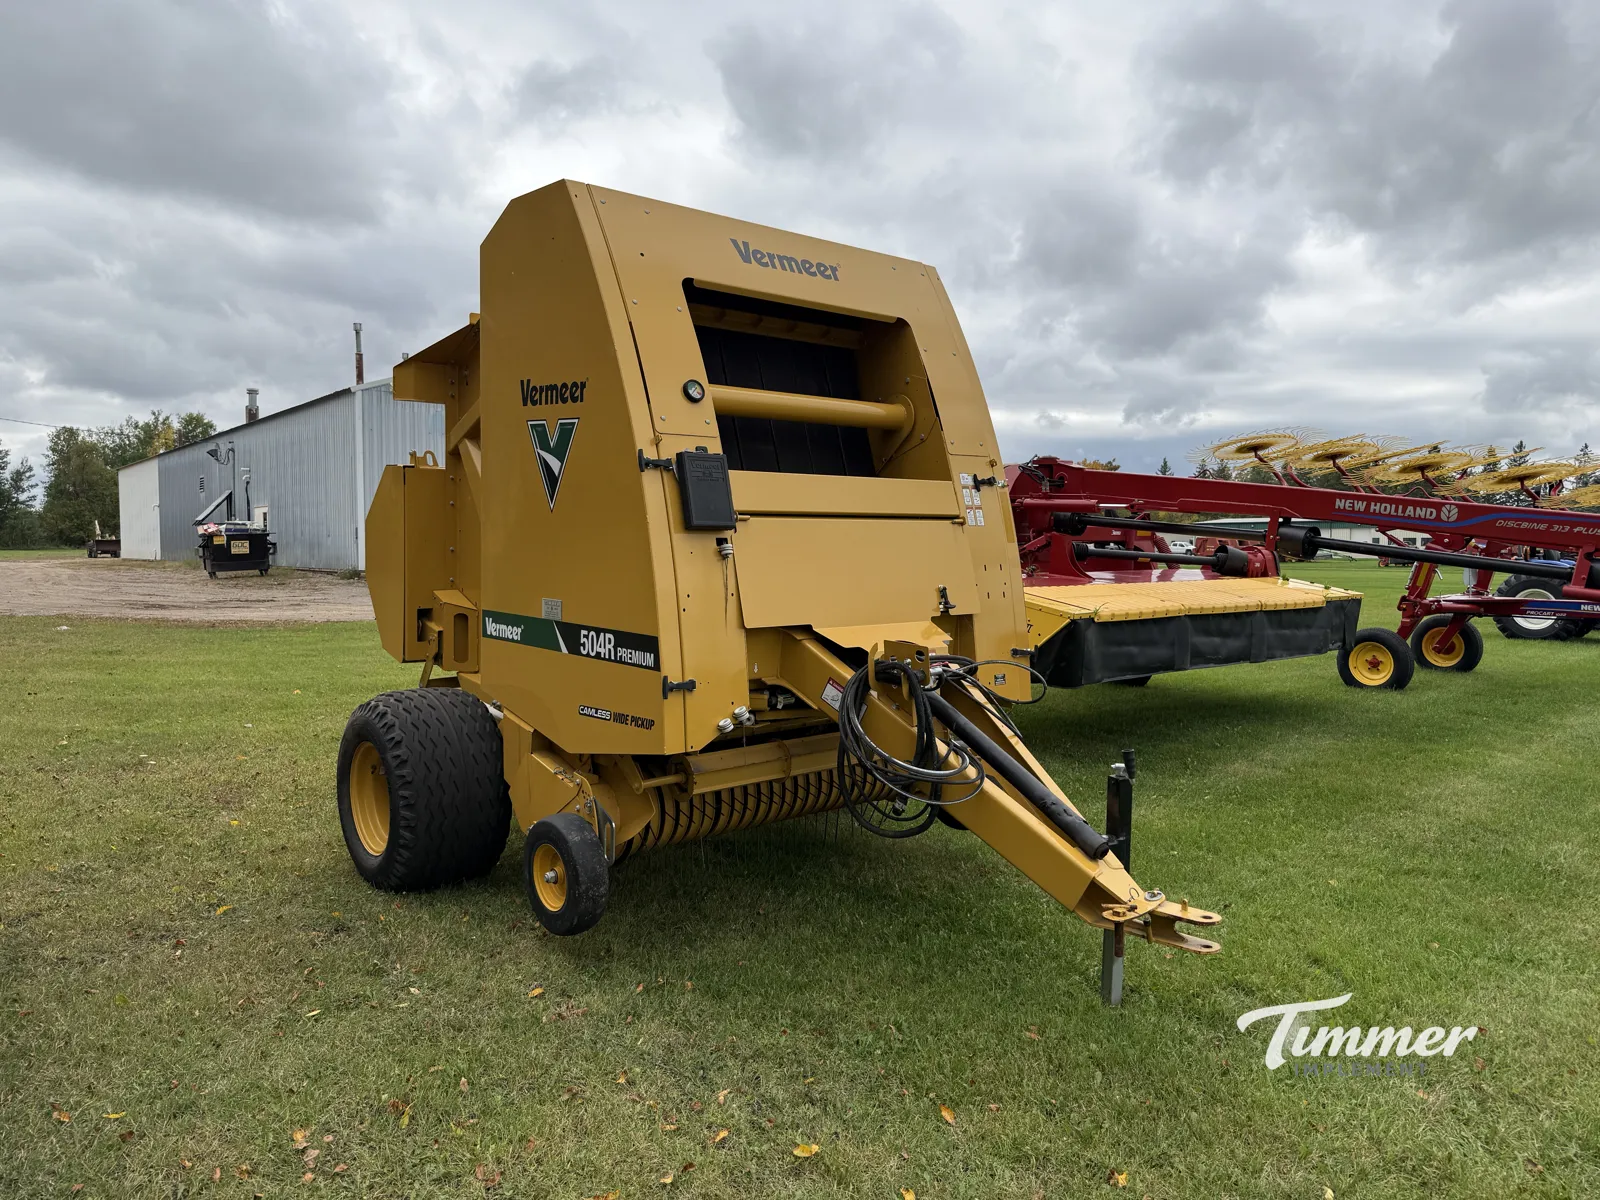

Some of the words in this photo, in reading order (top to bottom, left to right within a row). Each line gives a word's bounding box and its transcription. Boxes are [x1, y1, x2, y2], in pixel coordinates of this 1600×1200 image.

[729, 238, 840, 281] Vermeer
[520, 378, 588, 407] Vermeer
[1335, 498, 1367, 511] NEW
[1370, 502, 1437, 519] HOLLAND
[1495, 520, 1548, 530] DISCBINE
[1550, 524, 1570, 532] 313
[485, 616, 523, 641] Vermeer
[580, 629, 615, 660] 504R
[617, 647, 654, 668] PREMIUM
[579, 705, 611, 720] CAMLESS
[613, 711, 629, 725] WIDE
[630, 715, 655, 731] PICKUP
